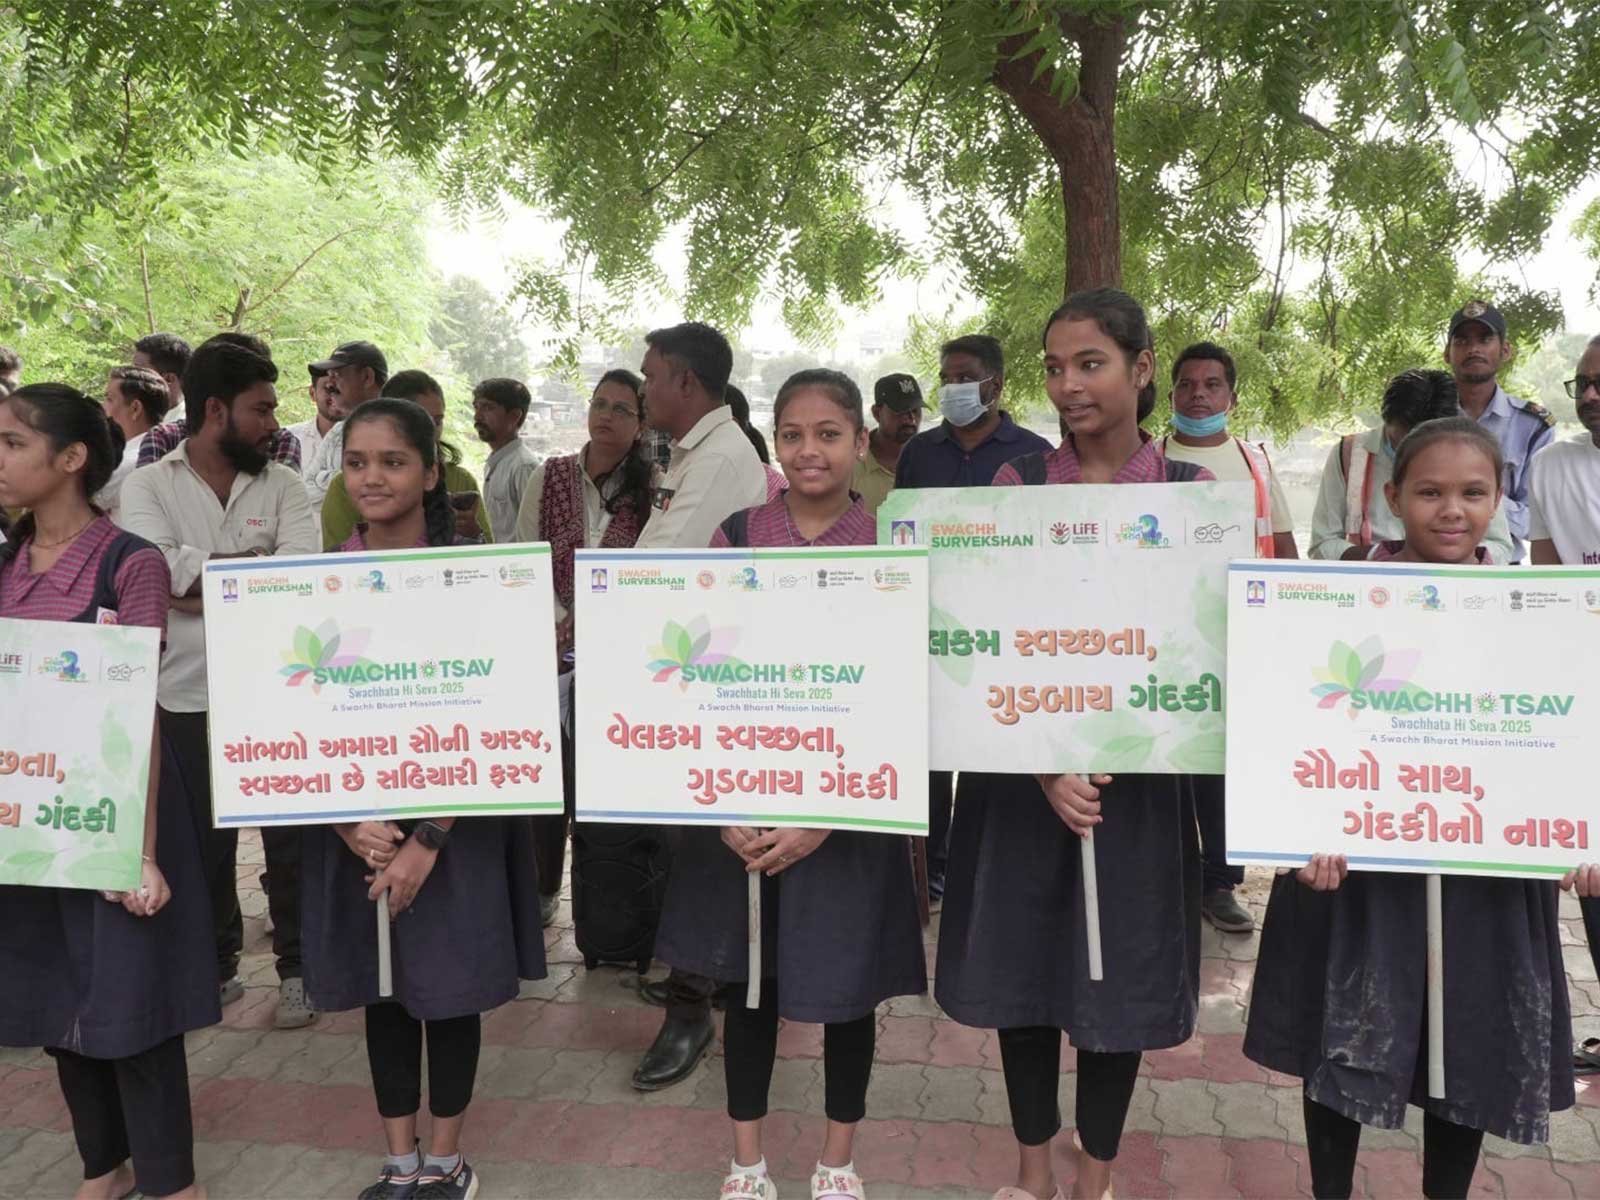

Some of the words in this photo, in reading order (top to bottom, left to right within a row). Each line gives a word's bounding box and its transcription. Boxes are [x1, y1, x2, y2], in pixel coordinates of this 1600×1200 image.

[931, 523, 996, 536] SWACHH
[1072, 522, 1100, 536] LiFE
[931, 535, 1034, 548] SURVEKSHAN
[617, 569, 661, 578] SWACHH
[247, 577, 289, 586] SWACHH
[247, 583, 313, 594] SURVEKSHAN
[617, 577, 686, 586] SURVEKSHAN
[1277, 583, 1328, 592] SWACHH
[1277, 591, 1355, 602] SURVEKSHAN
[929, 629, 1000, 657] લકમ
[1014, 628, 1158, 662] સ્વચ્છતા,
[349, 686, 400, 698] Swachhata
[403, 685, 413, 696] Hi
[416, 684, 438, 696] Seva
[440, 682, 464, 694] 2025
[716, 686, 768, 699] Swachhata
[770, 687, 781, 699] Hi
[783, 687, 806, 699] Seva
[808, 687, 833, 700] 2025
[341, 702, 375, 712] Swachh
[377, 700, 407, 710] Bharat
[410, 699, 442, 708] Mission
[444, 697, 482, 706] Initiative
[986, 684, 1113, 725] ગુડબાય
[1127, 673, 1222, 712] ગંદકી
[707, 703, 741, 712] Swachh
[744, 703, 774, 712] Bharat
[776, 704, 809, 713] Mission
[811, 705, 850, 714] Initiative
[1390, 716, 1451, 731] Swachhata
[1453, 718, 1467, 731] Hi
[1469, 719, 1497, 733] Seva
[1499, 720, 1533, 734] 2025
[607, 712, 701, 750] વેલકમ
[716, 724, 845, 758] સ્વચ્છતા,
[1370, 734, 1378, 743] A
[1381, 734, 1420, 745] Swachh
[1423, 736, 1459, 746] Bharat
[1461, 737, 1502, 748] Mission
[1504, 739, 1556, 749] Initiative
[224, 731, 308, 763] સાંભળો
[319, 735, 398, 758] અમારા
[409, 723, 470, 754] સૌની
[480, 729, 552, 753] અરજ,
[239, 773, 332, 797] સ્વચ્છતા
[341, 762, 365, 791] છે
[376, 757, 478, 790] સહિયારી
[489, 763, 543, 788] ફરજ
[1293, 748, 1380, 791] સૌનો
[1397, 763, 1485, 801] સાથ,
[687, 768, 804, 805] ગુડબાય
[819, 763, 898, 800] ગંદકી
[35, 795, 117, 834] ગંદકી
[1342, 801, 1483, 845] ગંદકીનો
[1503, 818, 1589, 850] નાશ
